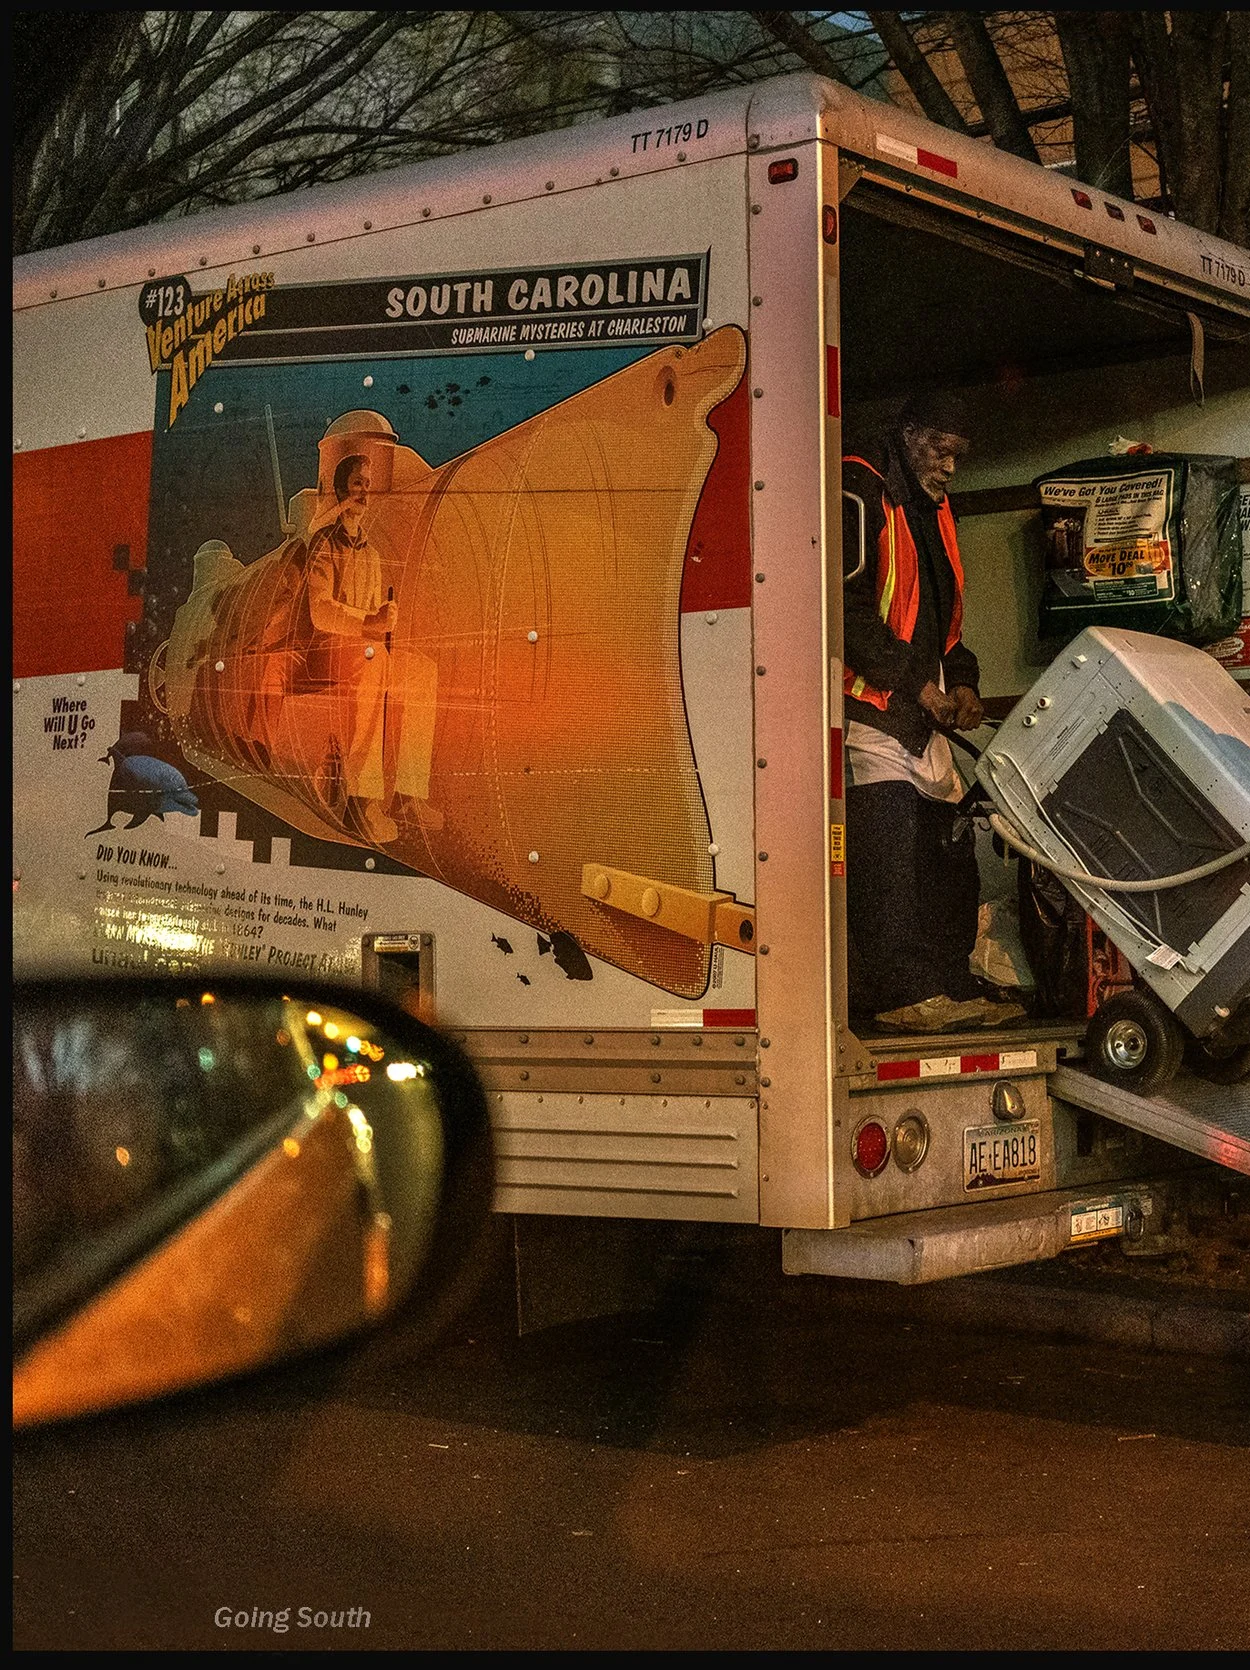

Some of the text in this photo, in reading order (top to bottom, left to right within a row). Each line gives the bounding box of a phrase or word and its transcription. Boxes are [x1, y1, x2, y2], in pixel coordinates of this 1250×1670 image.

[631, 118, 709, 153] TT 7179 D
[1200, 254, 1246, 287] TT 7179 D
[145, 285, 185, 317] #123
[385, 267, 691, 318] SOUTH CAROLINA
[147, 271, 276, 375] Venture Across
[452, 315, 687, 346] SUBMARINE MYSTERIES AT CHARLESTON
[169, 293, 266, 428] America
[1044, 478, 1163, 497] We've Got You Covered!
[1119, 549, 1145, 561] DEAL
[52, 697, 87, 714] Where
[44, 714, 95, 735] Will U Go
[53, 732, 87, 750] Next?
[96, 844, 177, 870] DID YOU KNOW...
[97, 869, 369, 921] Using revolutionary technology ahead of its time, the H.L. Hunley
[224, 904, 337, 932] designs for decades. What
[232, 923, 264, 939] 1864?
[268, 945, 317, 971] PROJECT
[984, 1127, 1024, 1137] ARIZONA
